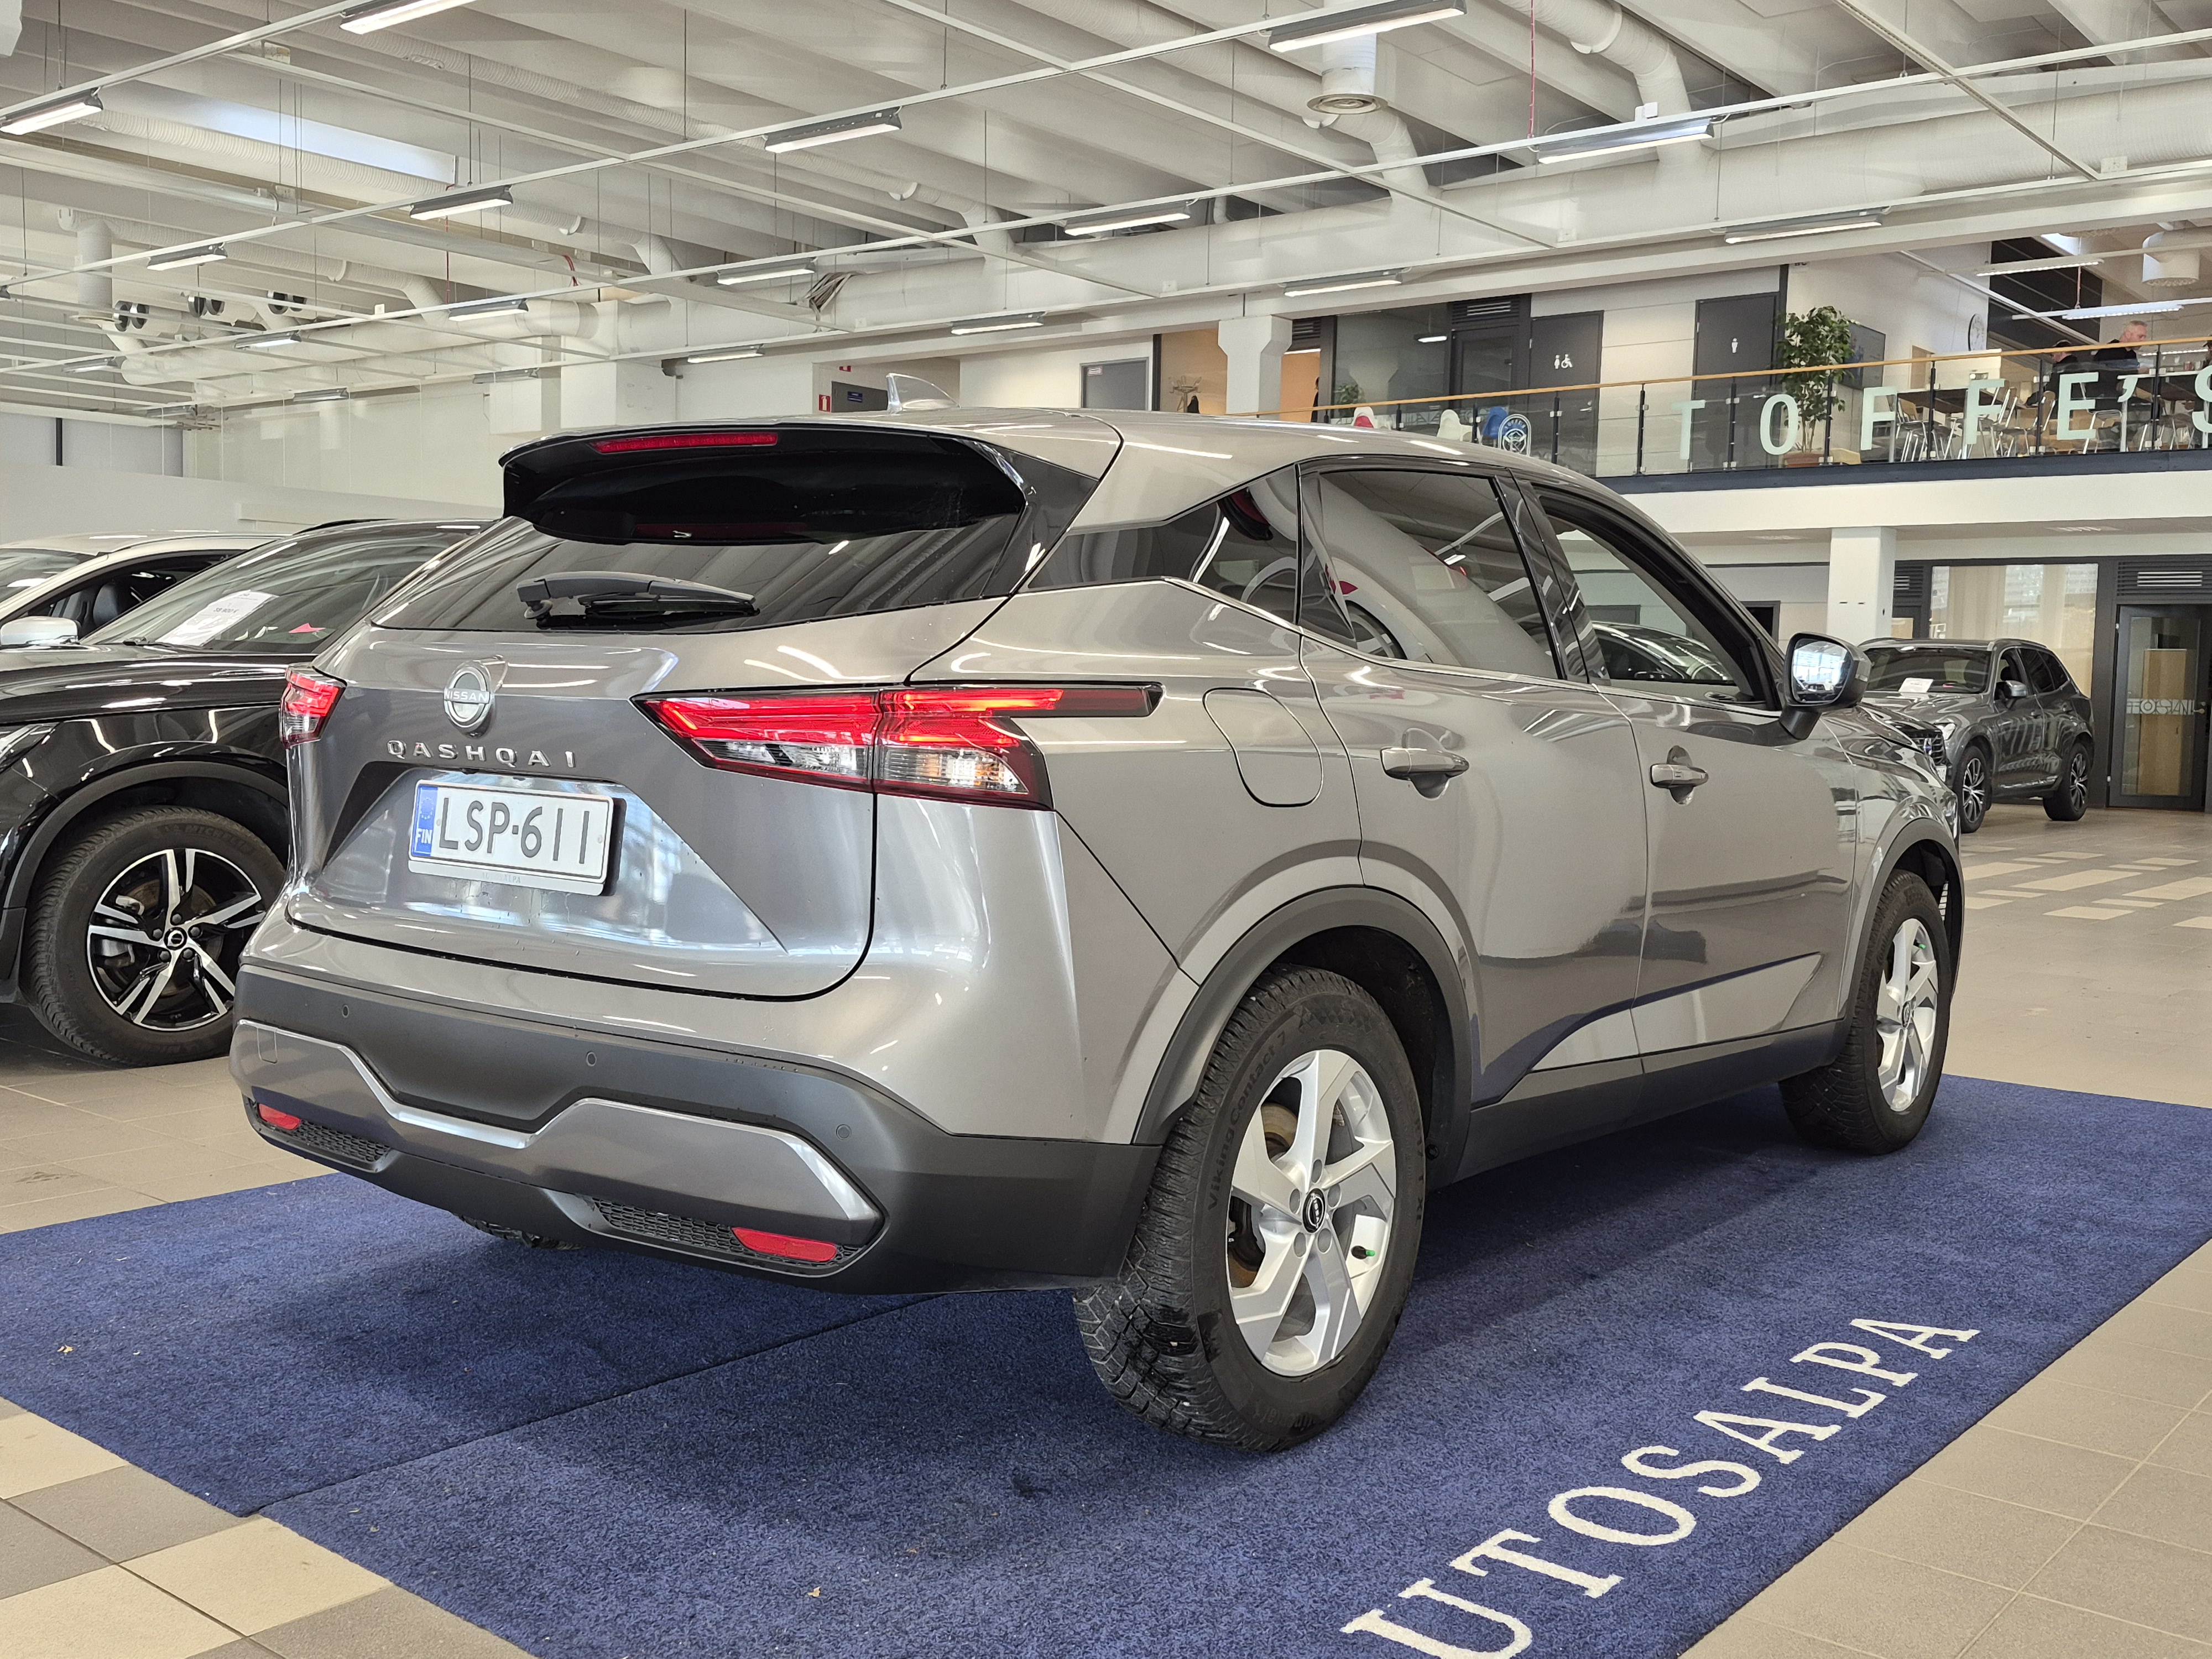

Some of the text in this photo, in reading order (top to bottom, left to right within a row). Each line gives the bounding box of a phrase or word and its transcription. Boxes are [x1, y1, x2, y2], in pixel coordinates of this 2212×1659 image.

[444, 689, 488, 702] NISSAN
[387, 740, 576, 768] QASHQAI
[415, 797, 590, 864] FIN LSP-611
